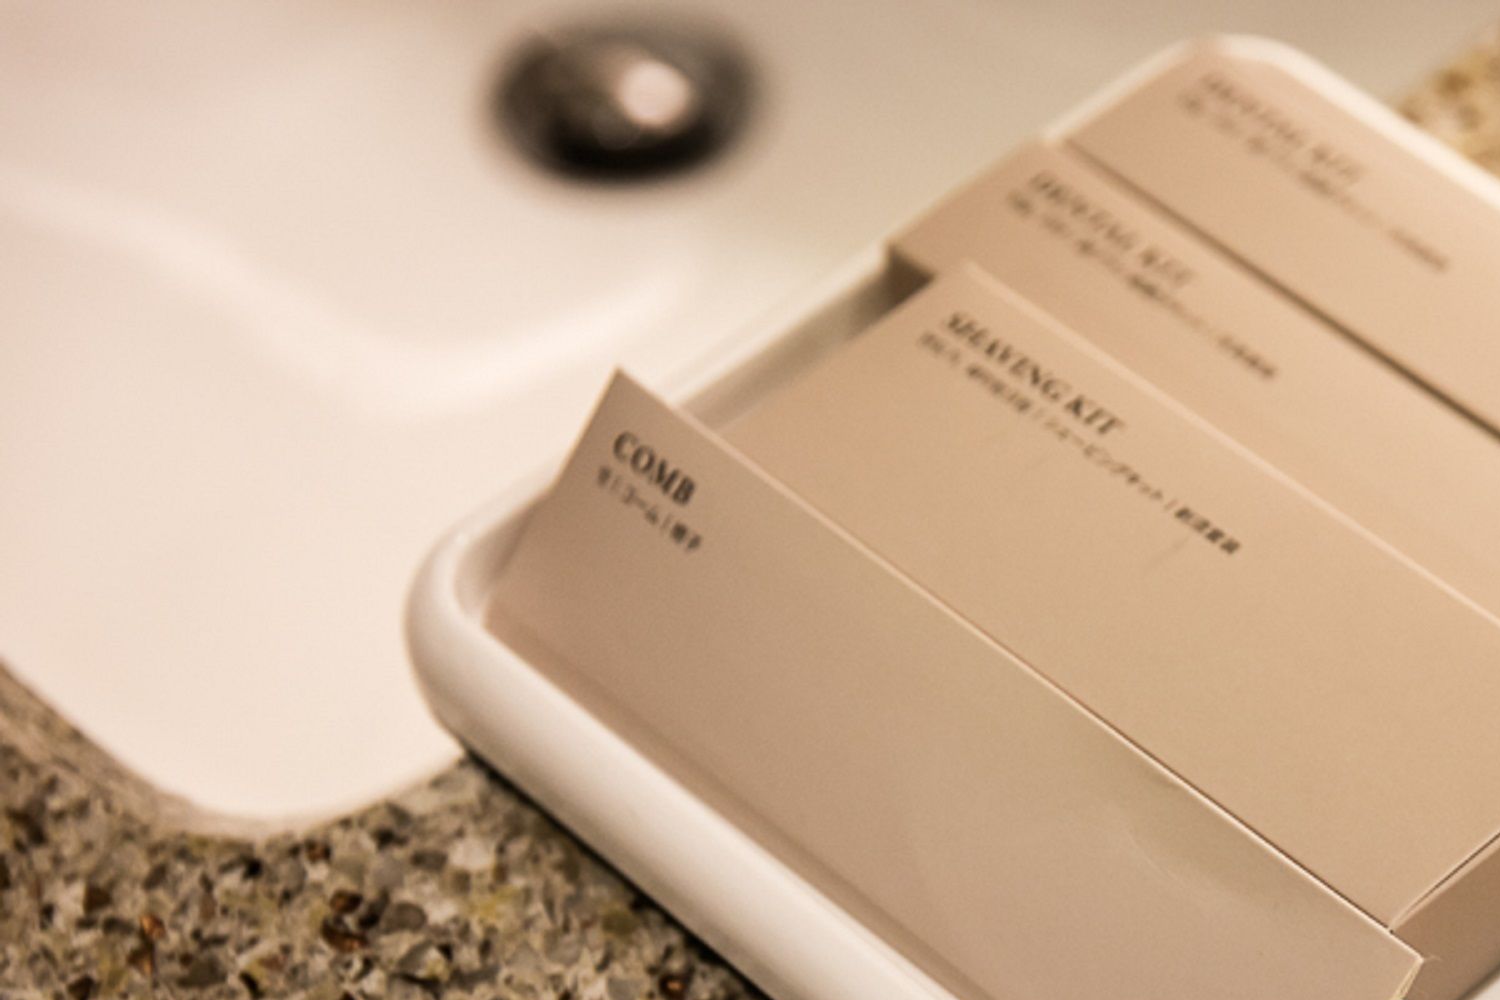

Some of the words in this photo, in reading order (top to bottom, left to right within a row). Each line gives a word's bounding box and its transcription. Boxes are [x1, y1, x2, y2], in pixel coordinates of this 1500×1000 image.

[944, 311, 1077, 405] SHAVING
[1065, 391, 1125, 437] KIT
[612, 430, 698, 508] COMB
